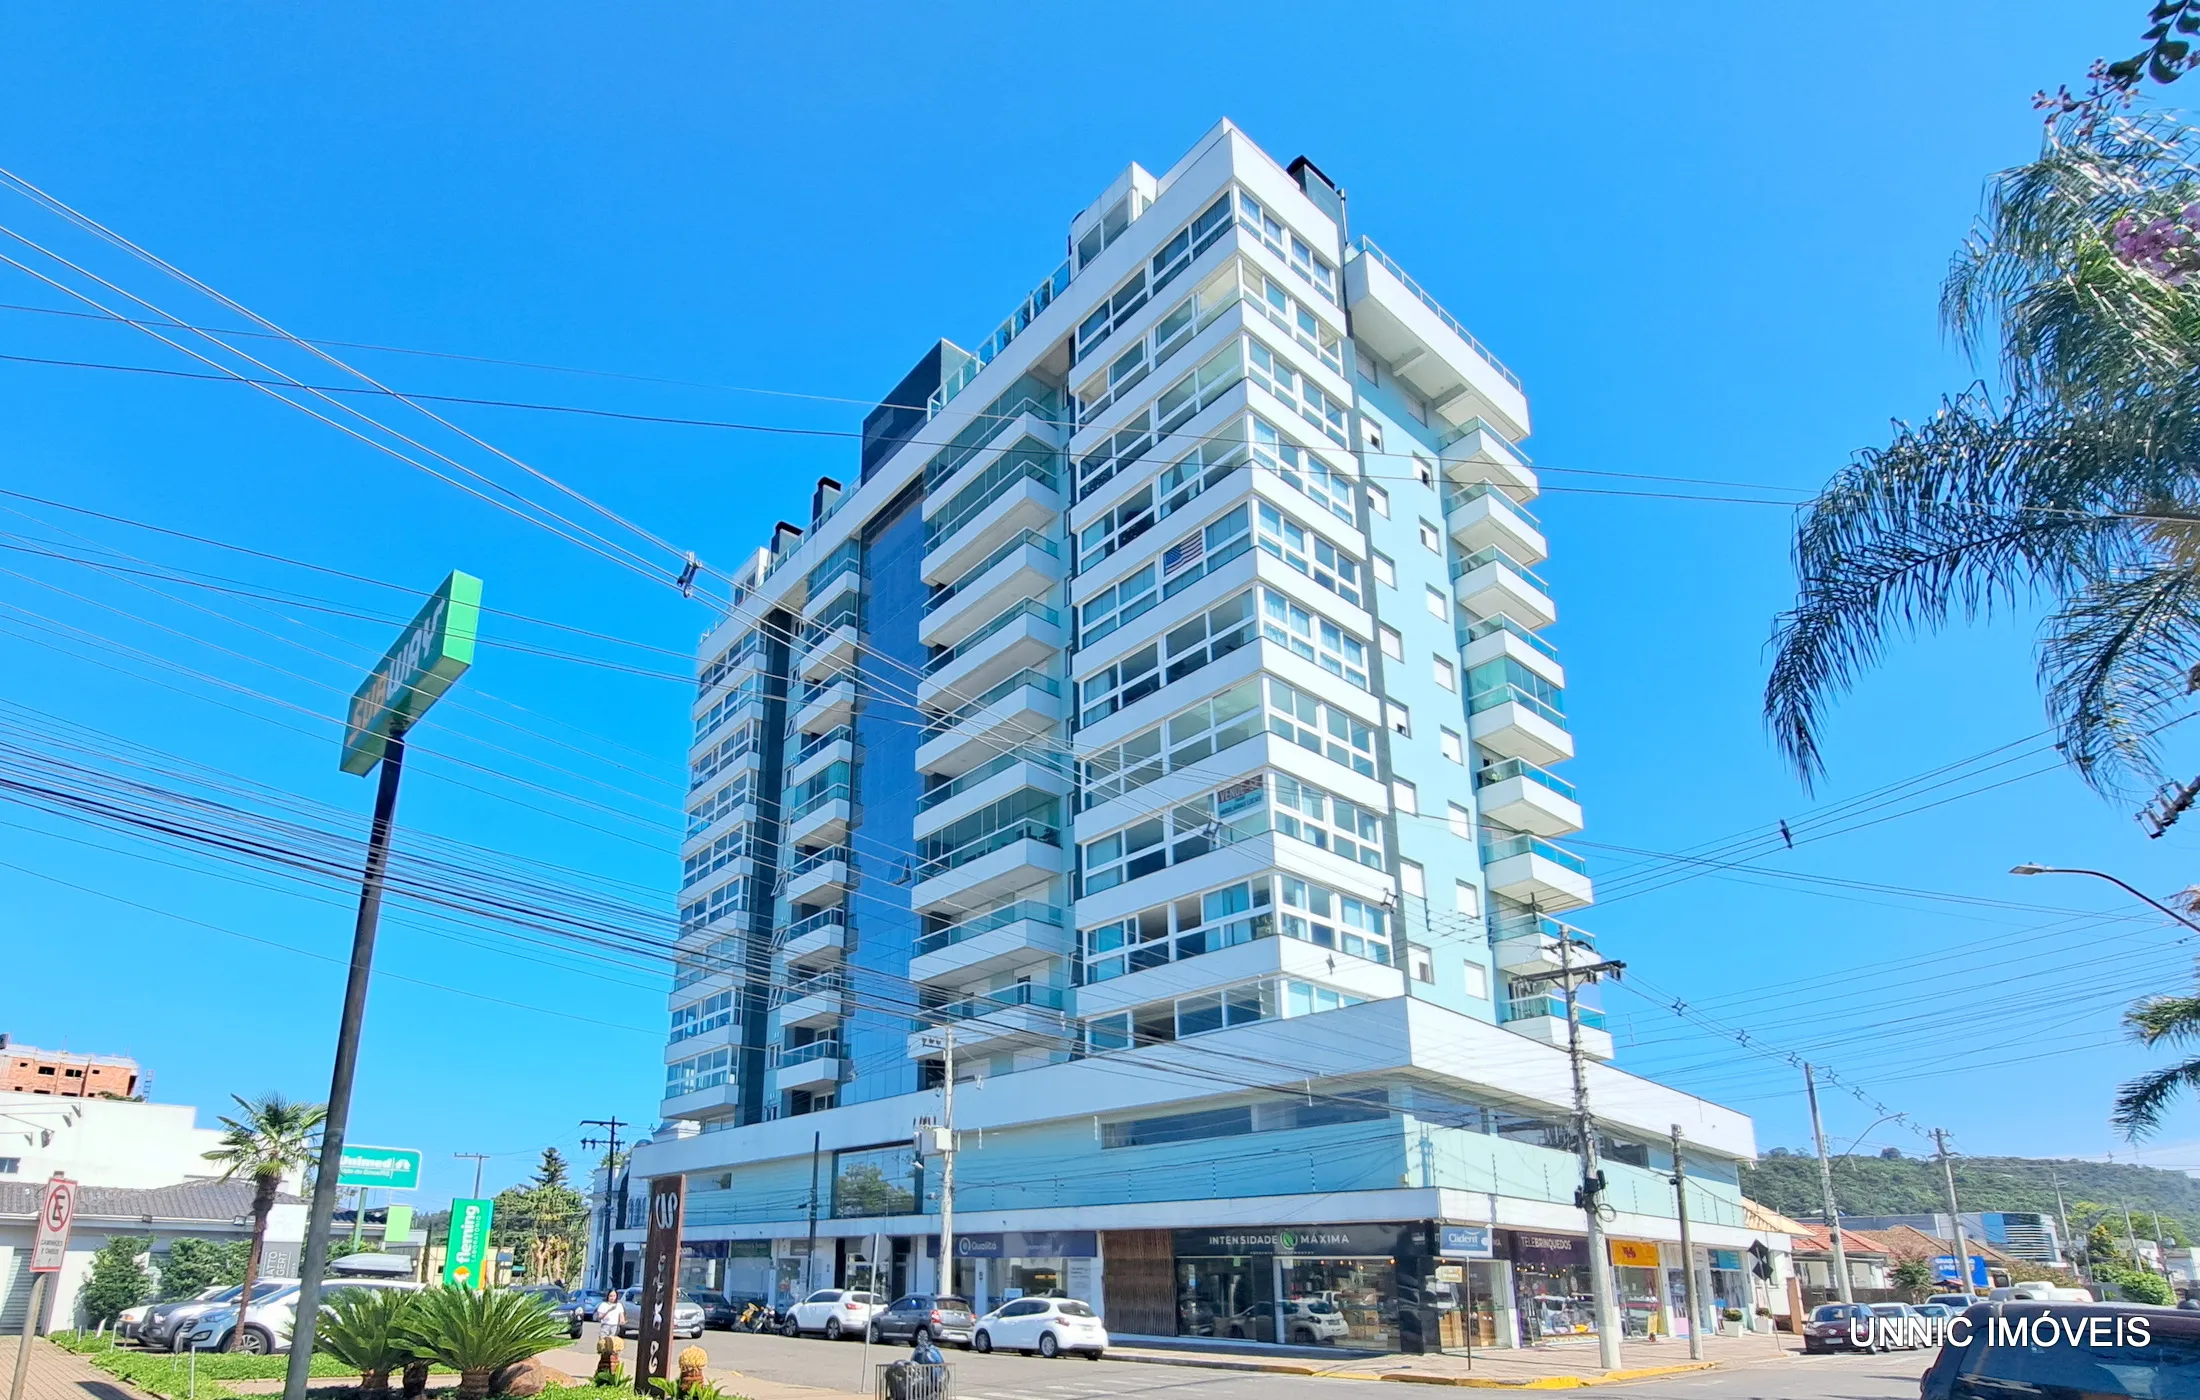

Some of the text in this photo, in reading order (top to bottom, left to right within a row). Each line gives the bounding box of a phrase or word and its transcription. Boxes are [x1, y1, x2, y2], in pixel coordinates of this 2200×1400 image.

[456, 1205, 480, 1264] fleming
[1209, 1232, 1350, 1245] INTENSIDADE MÁXIMA
[1520, 1236, 1572, 1251] TELEBRINQUEDOS
